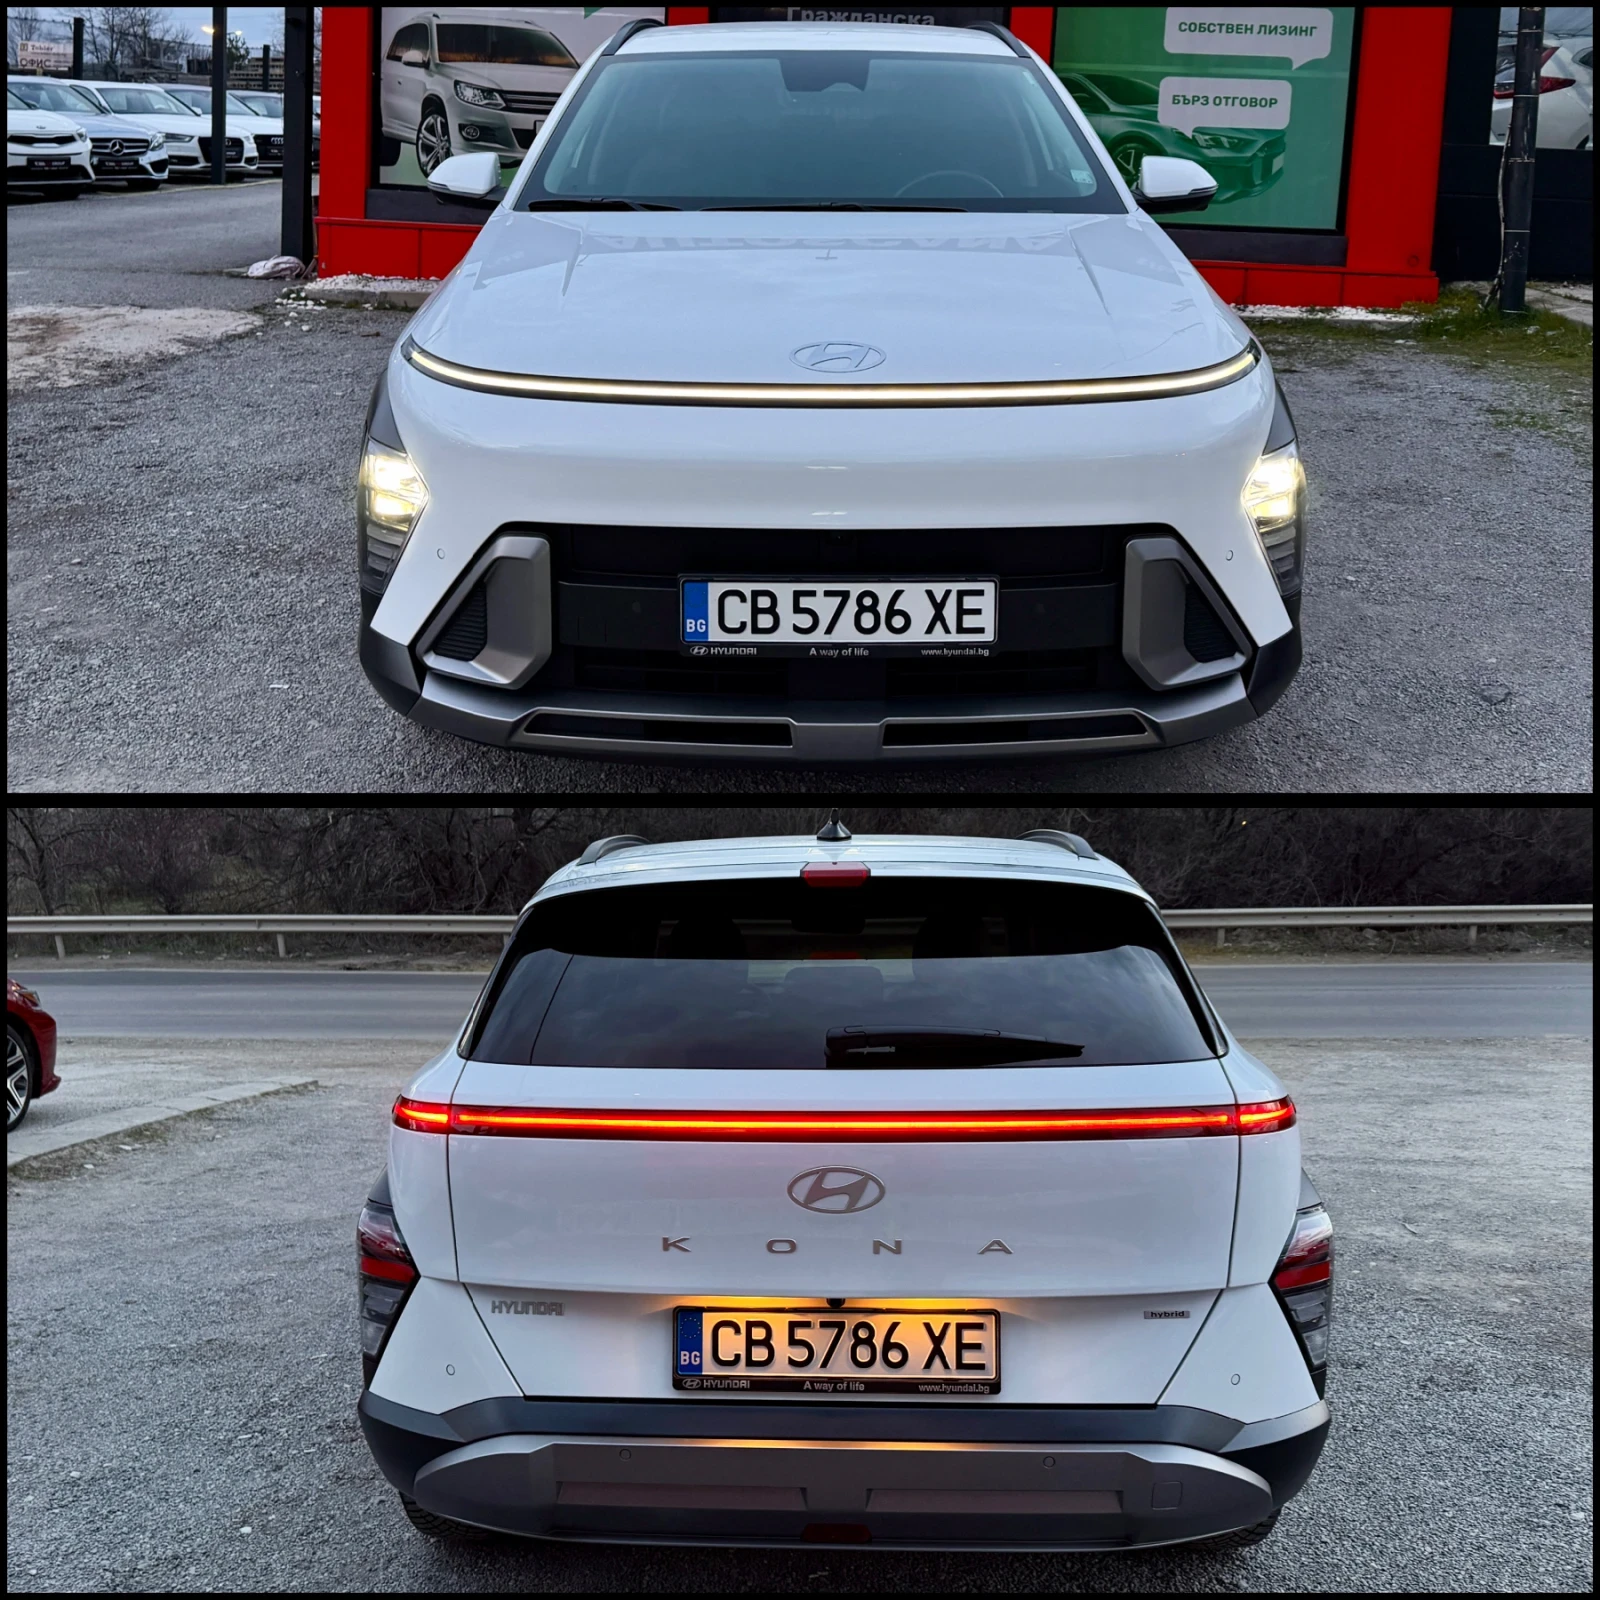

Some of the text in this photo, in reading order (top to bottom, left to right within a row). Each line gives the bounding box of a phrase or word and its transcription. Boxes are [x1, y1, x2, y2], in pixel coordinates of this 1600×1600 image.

[787, 7, 935, 26] Гражданска
[1178, 22, 1318, 37] СОБСТВЕН ЛИЗИНГ
[20, 58, 51, 67] ОФИС
[1171, 94, 1278, 108] БЪРЗ ОТГОВОР
[717, 588, 985, 635] CB 5786 XE
[686, 619, 706, 632] BG
[710, 647, 757, 655] HYUNDAI
[809, 647, 869, 657] A way of life
[921, 648, 990, 657] www.hyundai.bg
[662, 1236, 1014, 1255] KONA
[491, 1300, 564, 1316] HYUNDAI
[711, 1319, 986, 1370] CB 5786 XE
[680, 1351, 700, 1365] BG
[703, 1379, 750, 1389] HYUNDAI
[803, 1381, 865, 1392] A way of life
[918, 1384, 990, 1394] www.hyundai.bg
